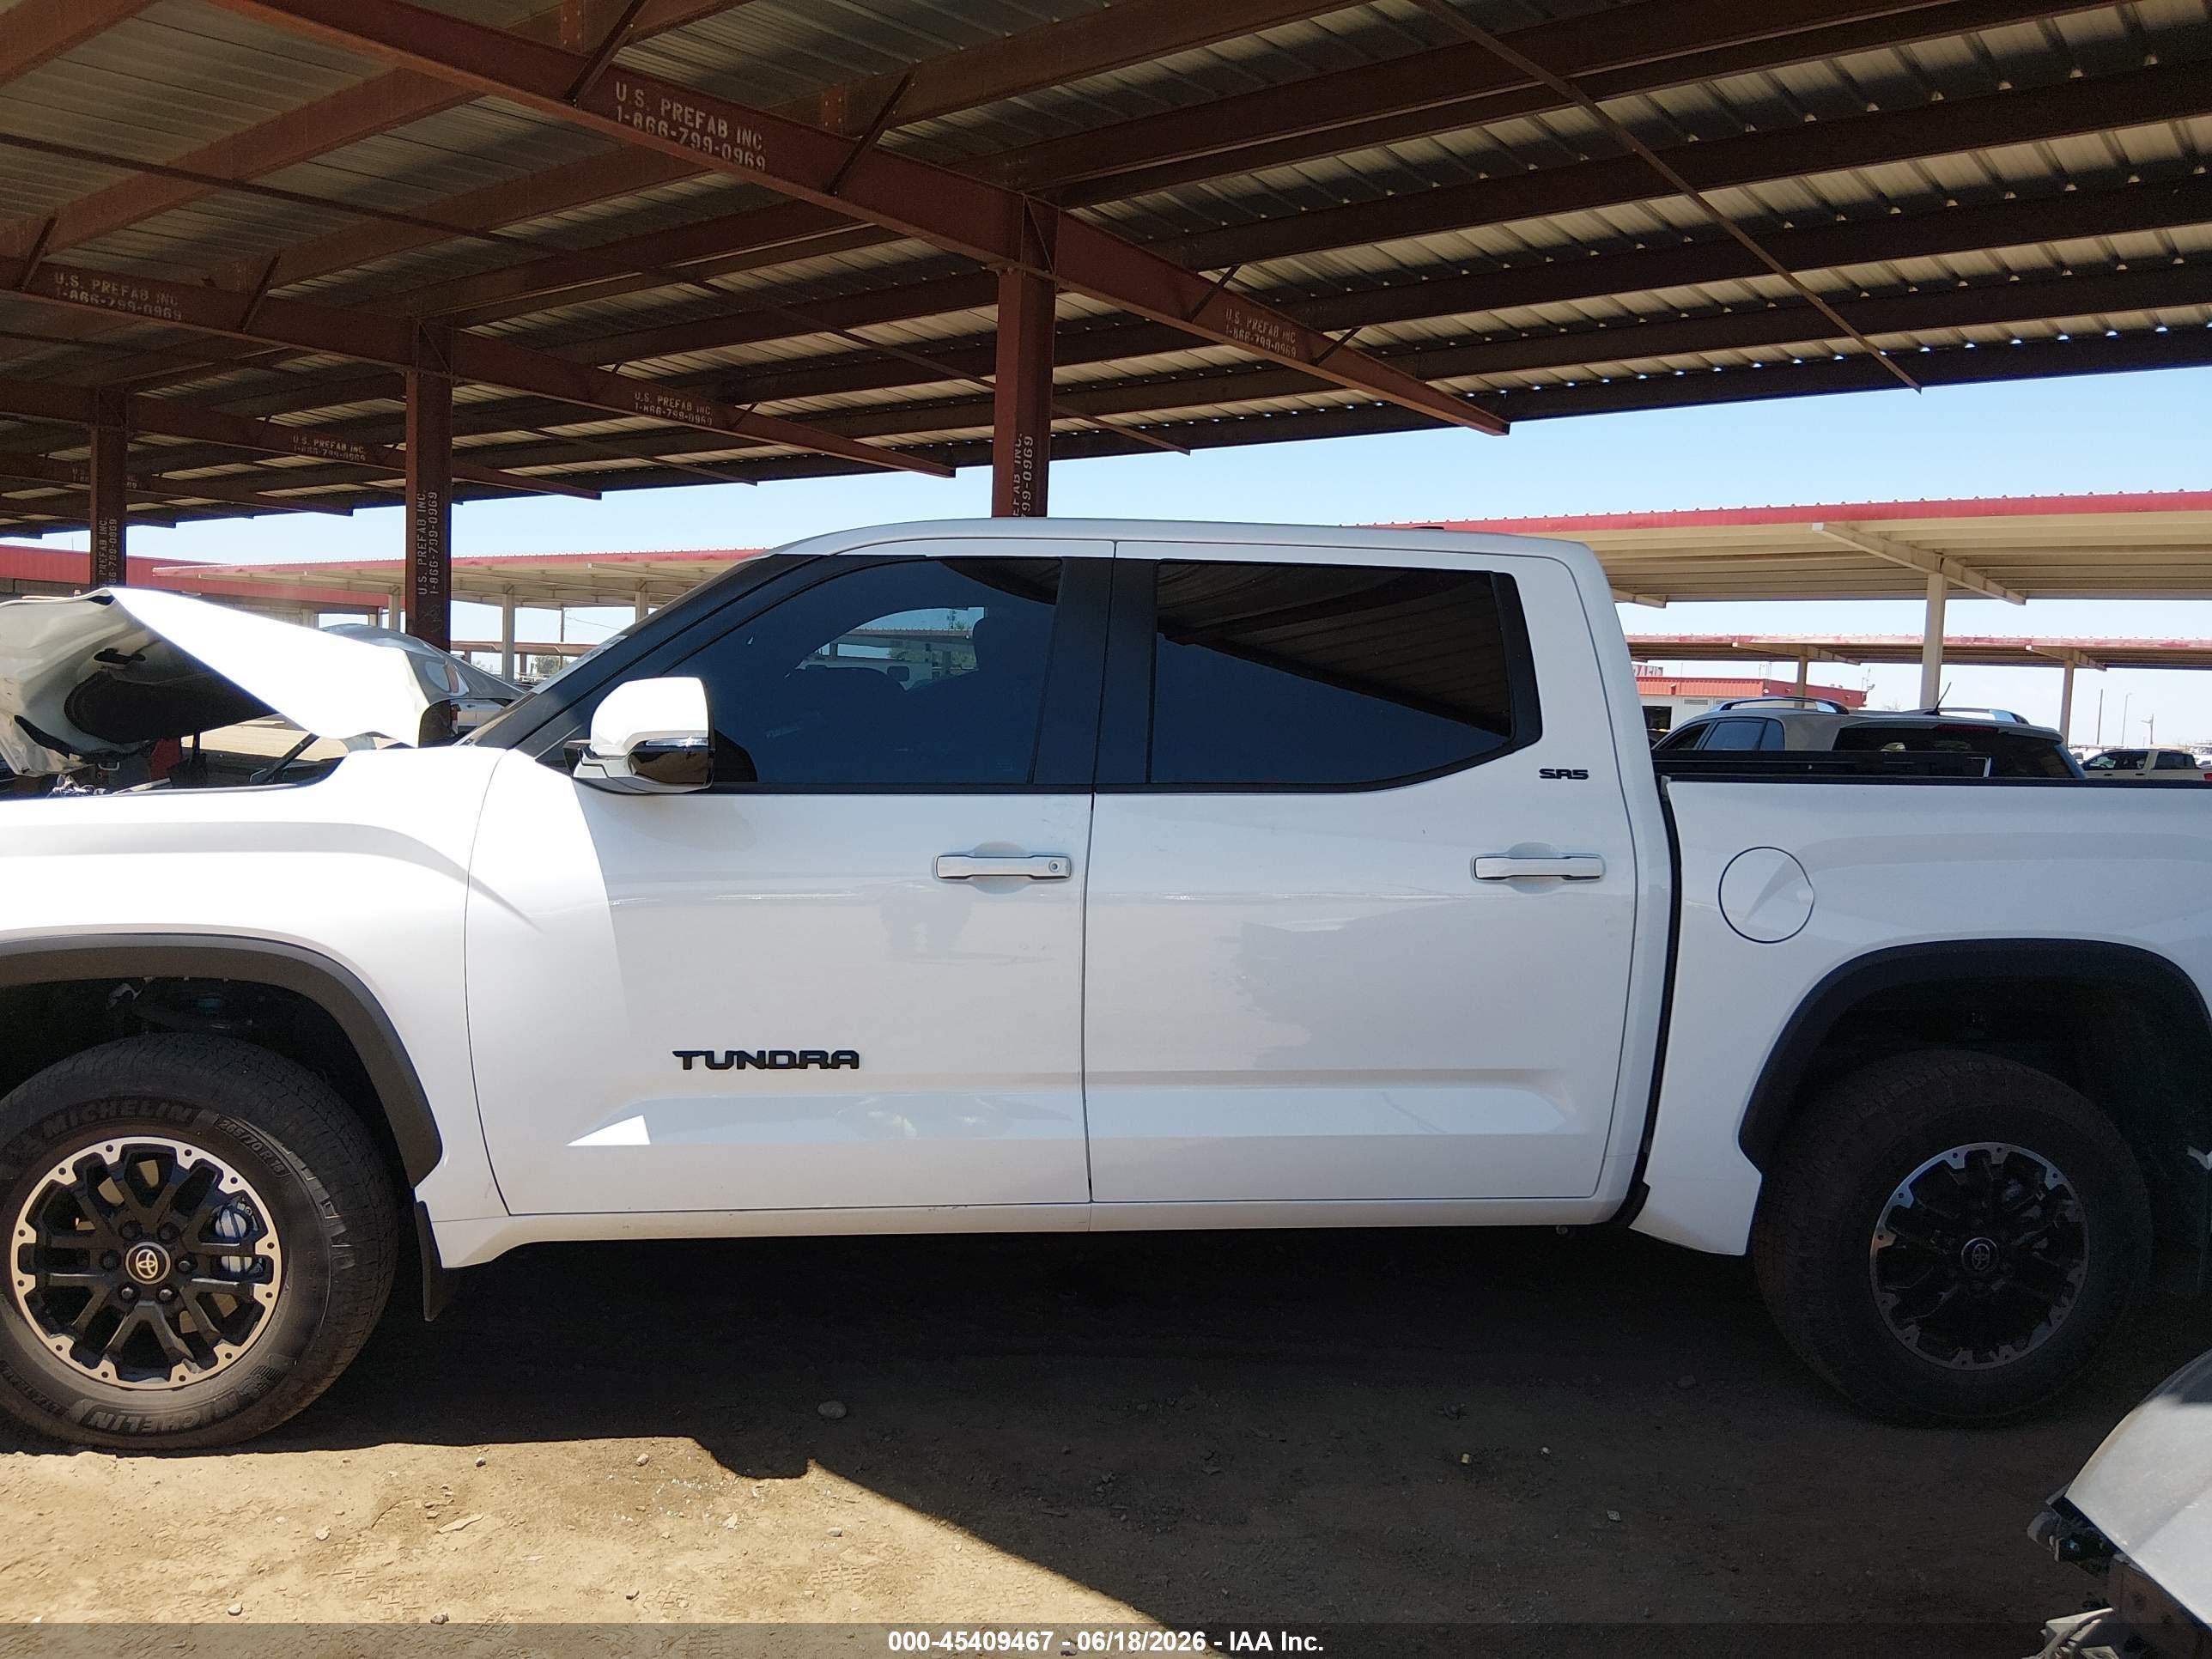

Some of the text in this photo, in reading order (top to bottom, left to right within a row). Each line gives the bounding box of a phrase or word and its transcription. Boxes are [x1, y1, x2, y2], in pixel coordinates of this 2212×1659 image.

[660, 97, 728, 139] PREFAB
[616, 105, 767, 172] 1-866-799-0969
[55, 272, 84, 289] U.S.
[92, 279, 149, 301] PREFAB
[56, 287, 182, 320] 1-866-799-0969
[657, 395, 693, 412] PREFAB
[416, 519, 428, 566] PREFAB
[428, 491, 440, 595] 1-866-799-0969
[672, 1050, 860, 1070] TUNDRA
[43, 1097, 192, 1139] MICHELIN
[88, 1393, 240, 1432] MICHELIN
